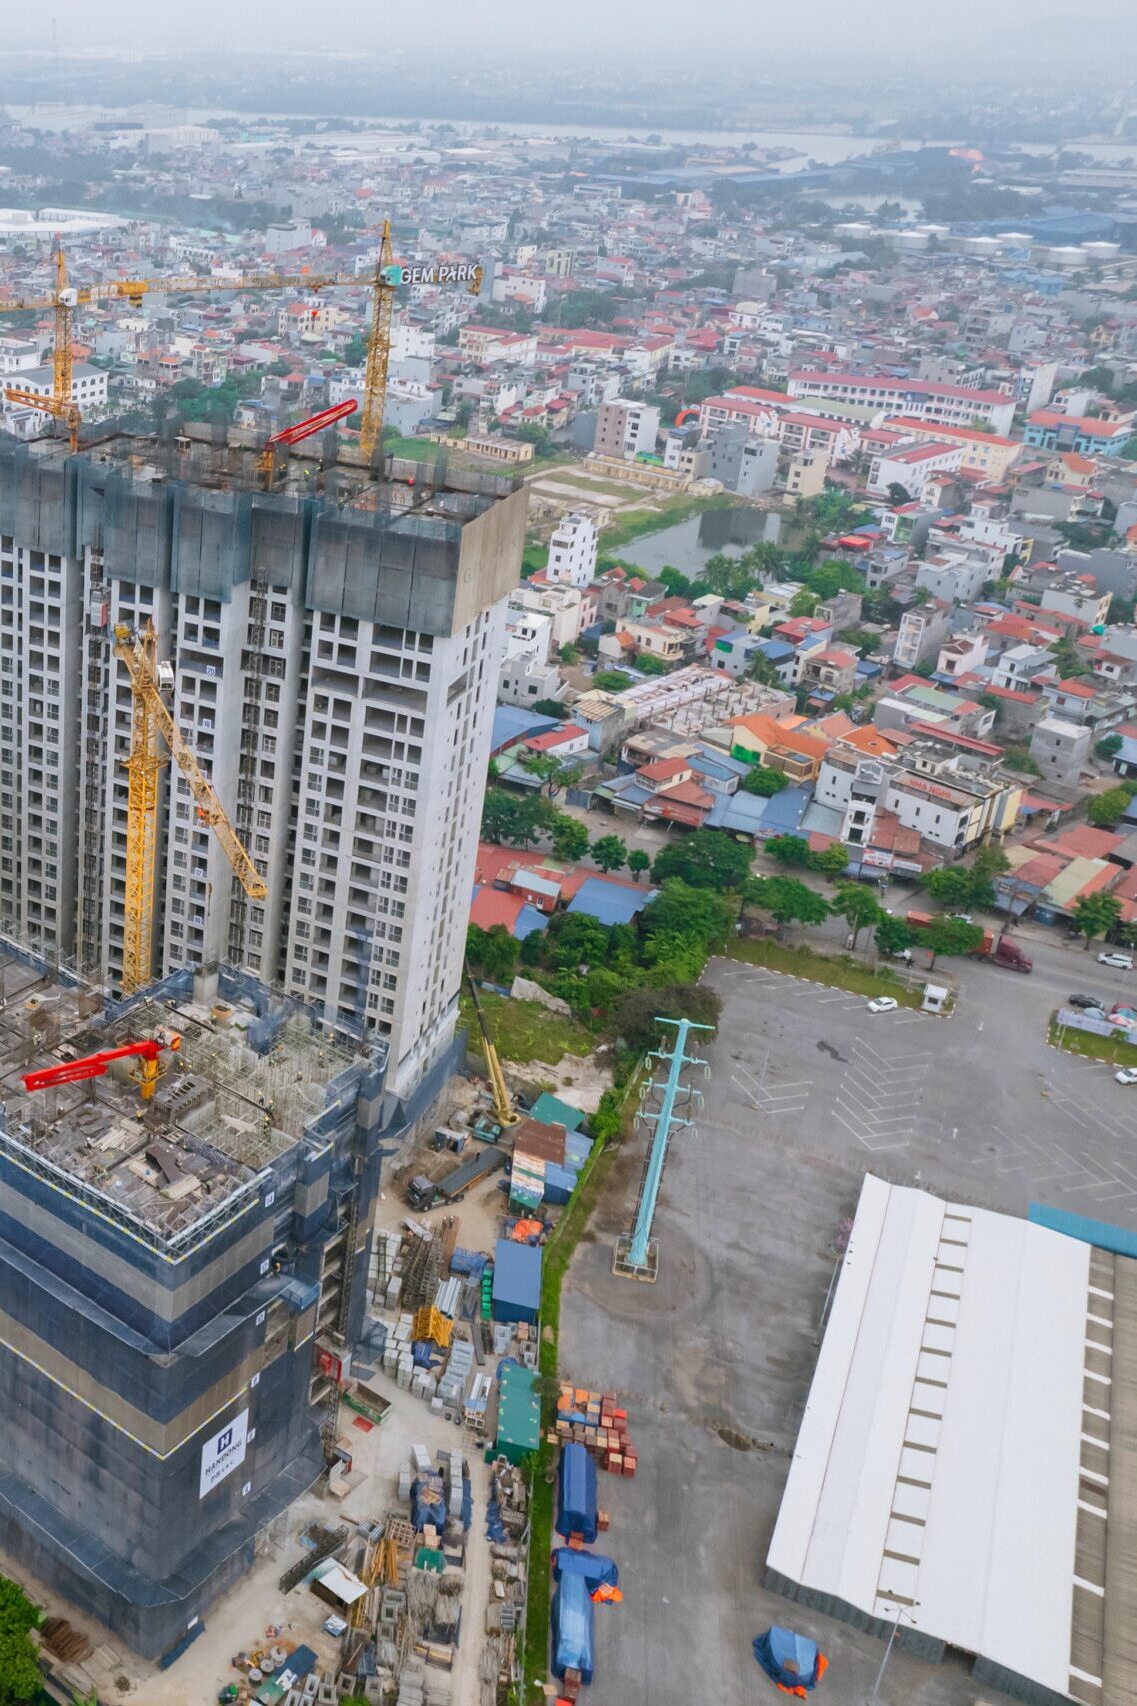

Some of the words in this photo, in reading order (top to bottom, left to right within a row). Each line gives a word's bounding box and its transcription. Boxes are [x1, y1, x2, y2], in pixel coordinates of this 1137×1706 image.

[400, 266, 434, 284] GEM
[438, 264, 479, 282] PARK
[205, 1440, 242, 1475] HANDONG
